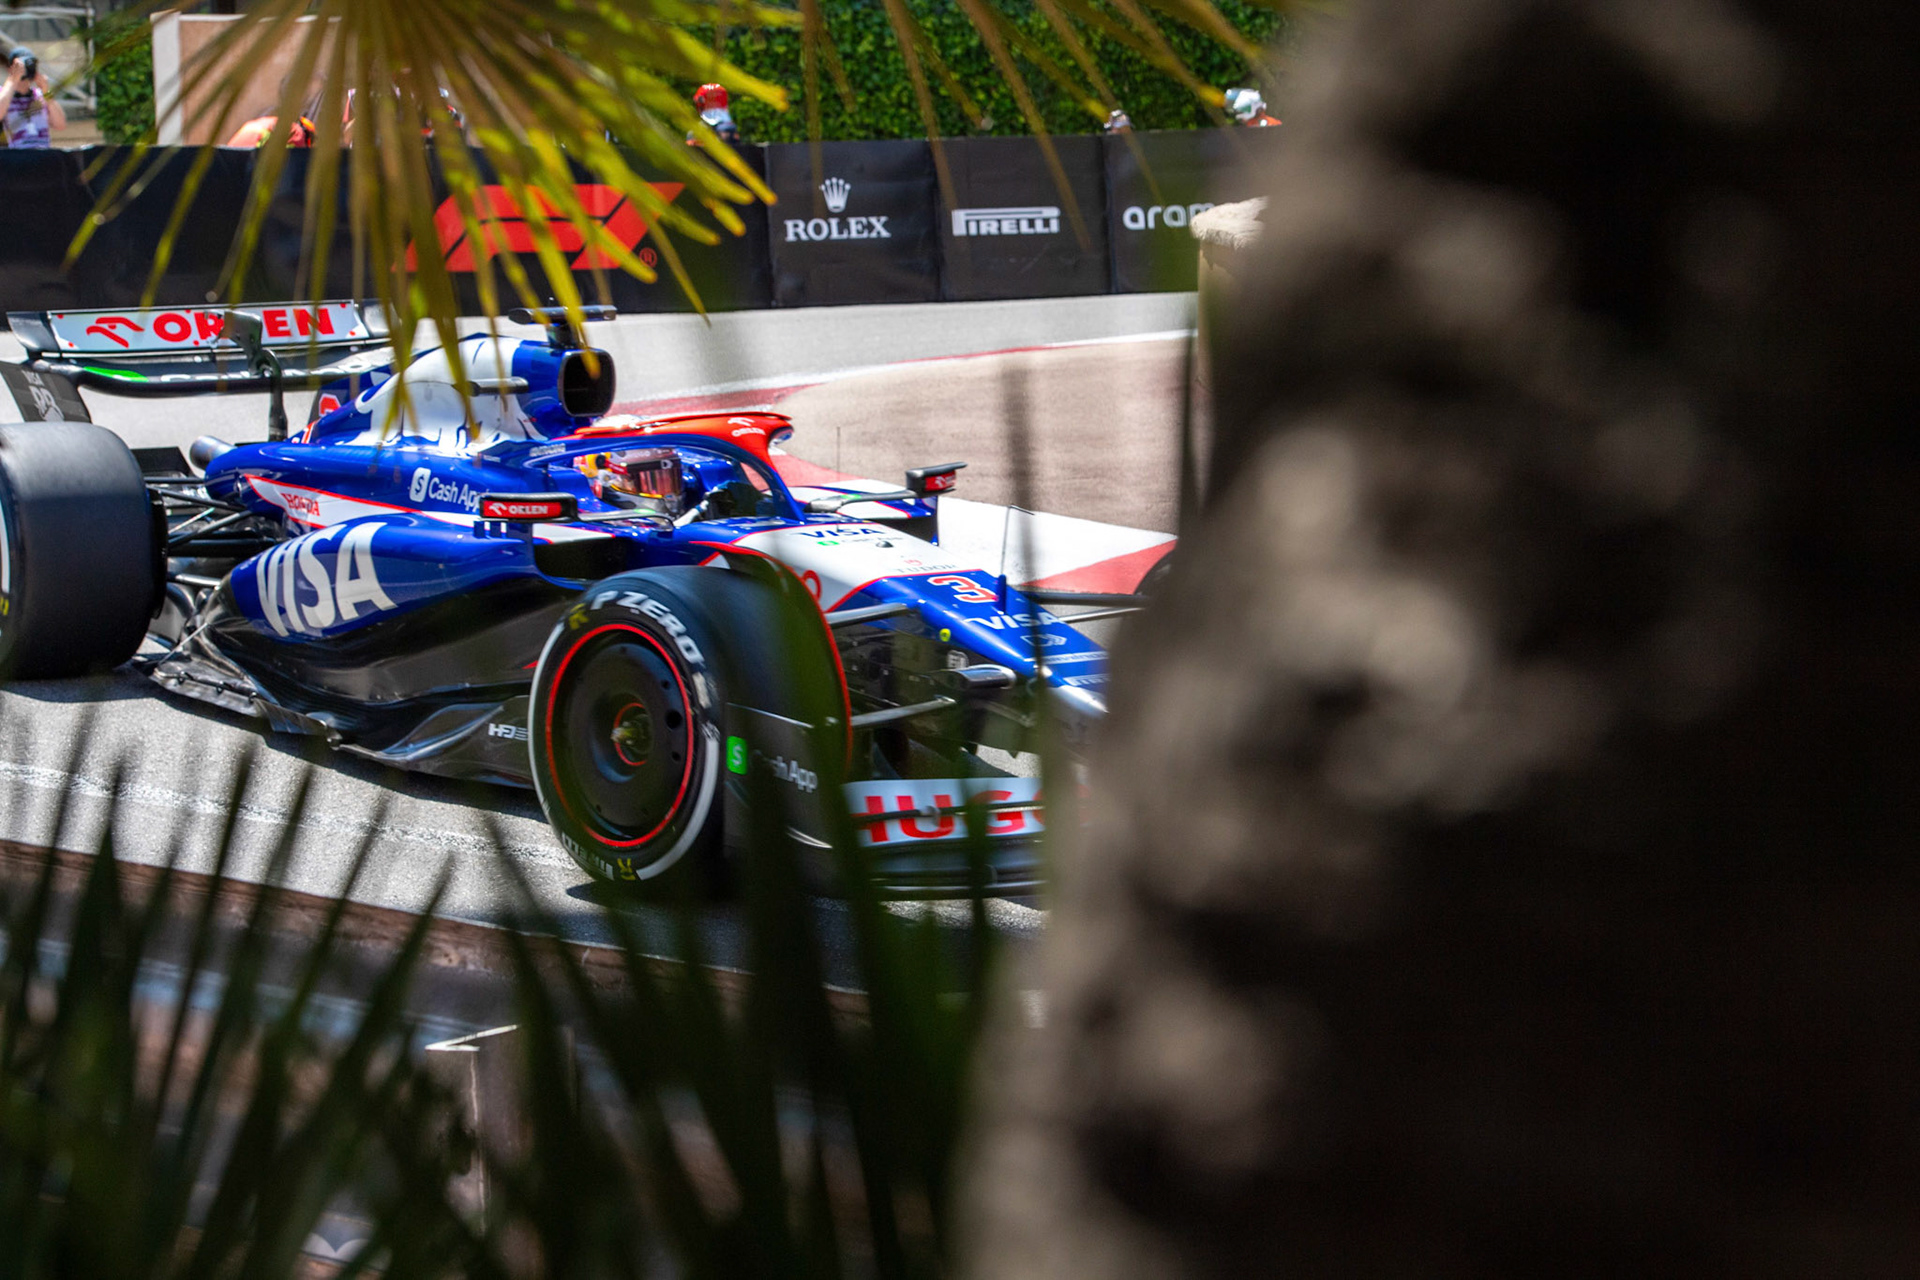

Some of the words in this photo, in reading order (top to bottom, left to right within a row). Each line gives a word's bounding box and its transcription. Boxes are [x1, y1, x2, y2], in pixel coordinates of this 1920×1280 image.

[784, 216, 892, 242] ROLEX
[951, 206, 1061, 237] PIRELLI
[152, 308, 335, 343] OREN
[428, 477, 459, 503] Cash
[280, 492, 321, 517] HONDA
[508, 505, 549, 515] ORLEN
[798, 527, 884, 538] VISA
[256, 521, 399, 637] VISA
[927, 575, 999, 603] 3
[616, 591, 705, 664] ZERO
[963, 612, 1067, 630] VISA
